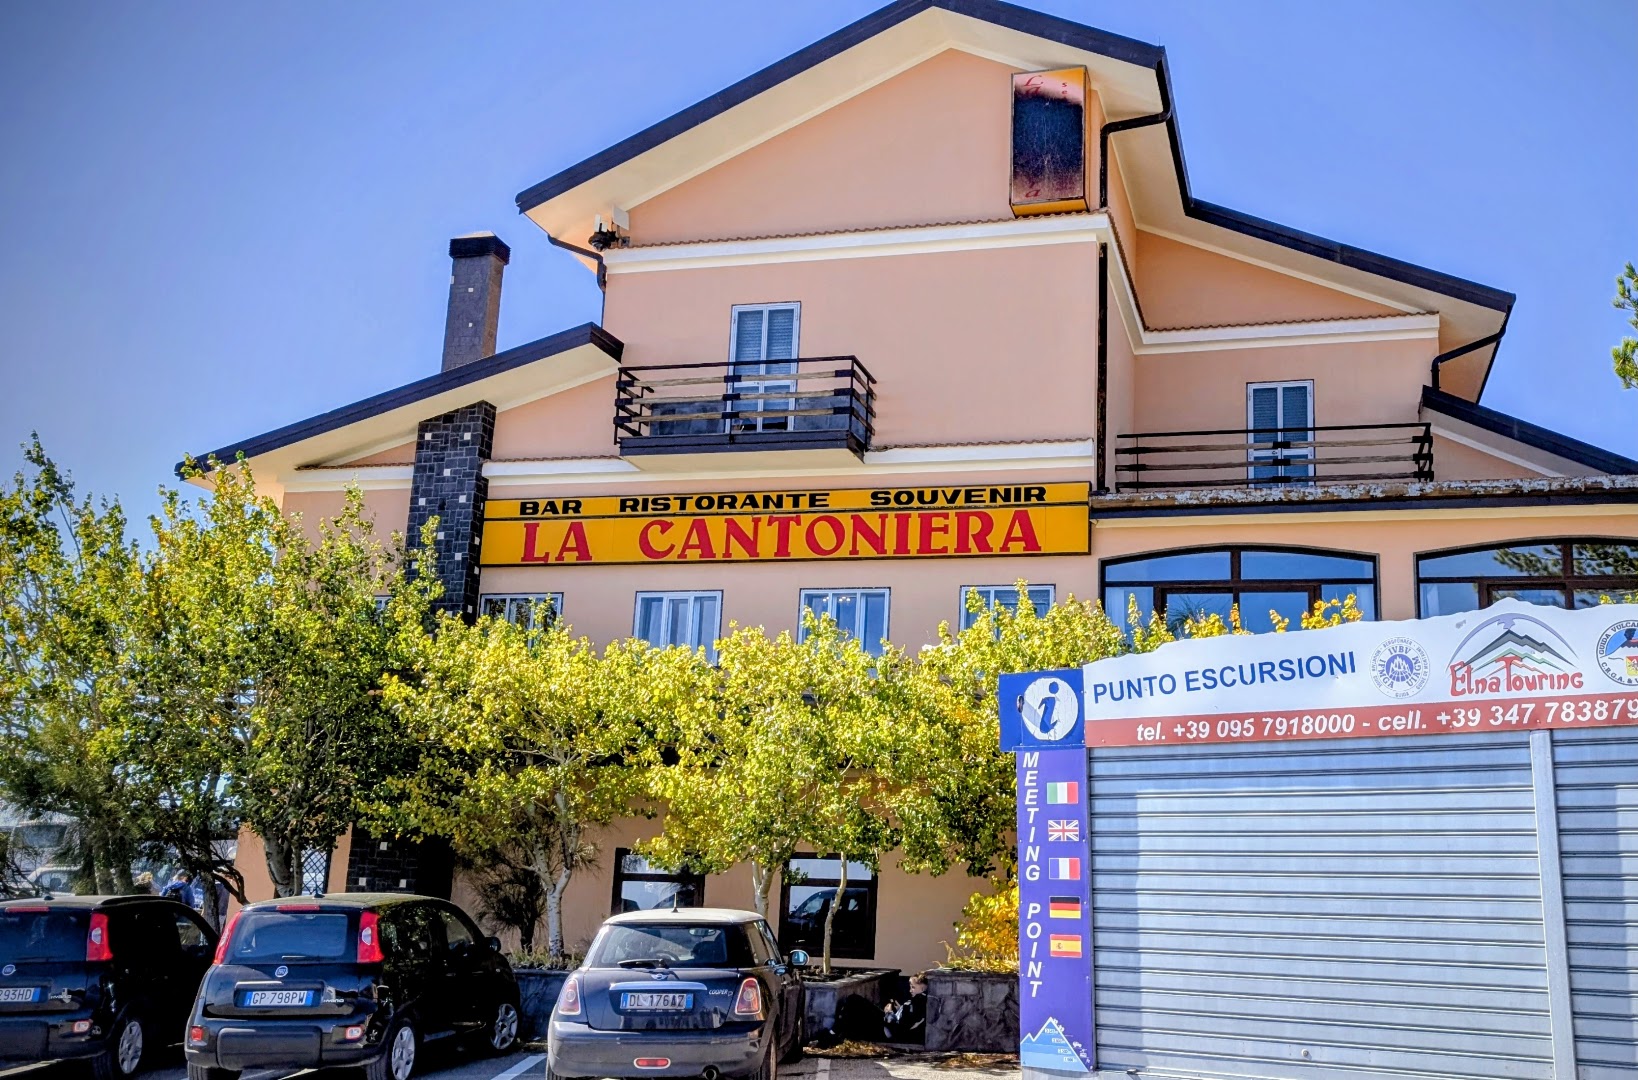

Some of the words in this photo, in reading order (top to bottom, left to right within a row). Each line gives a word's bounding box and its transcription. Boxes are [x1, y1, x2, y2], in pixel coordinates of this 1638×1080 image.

[519, 500, 582, 515] BAR
[619, 492, 830, 513] RISTORANTE
[870, 486, 1047, 506] SOUVENIR
[520, 521, 592, 563] LA
[639, 509, 1042, 560] CANTONIERA
[1388, 645, 1411, 655] IVBV
[1599, 633, 1611, 655] GUIDA
[1611, 621, 1638, 633] VULCA
[1093, 673, 1177, 704] PUNTO
[1185, 651, 1356, 693] ESCURSIONI
[1378, 659, 1394, 688] IFMGA
[1406, 656, 1421, 687] UIAGM
[1495, 655, 1584, 692] Touring
[1136, 722, 1166, 741] tel.
[1173, 721, 1210, 739] +39
[1216, 719, 1255, 738] 095
[1262, 714, 1355, 737] 7918000
[1378, 711, 1427, 731] cell.
[1436, 708, 1481, 728] +39
[1489, 703, 1535, 726] 347
[1022, 752, 1040, 881] MEETING
[1026, 903, 1042, 998] POINT
[650, 994, 684, 1006] 176AZ
